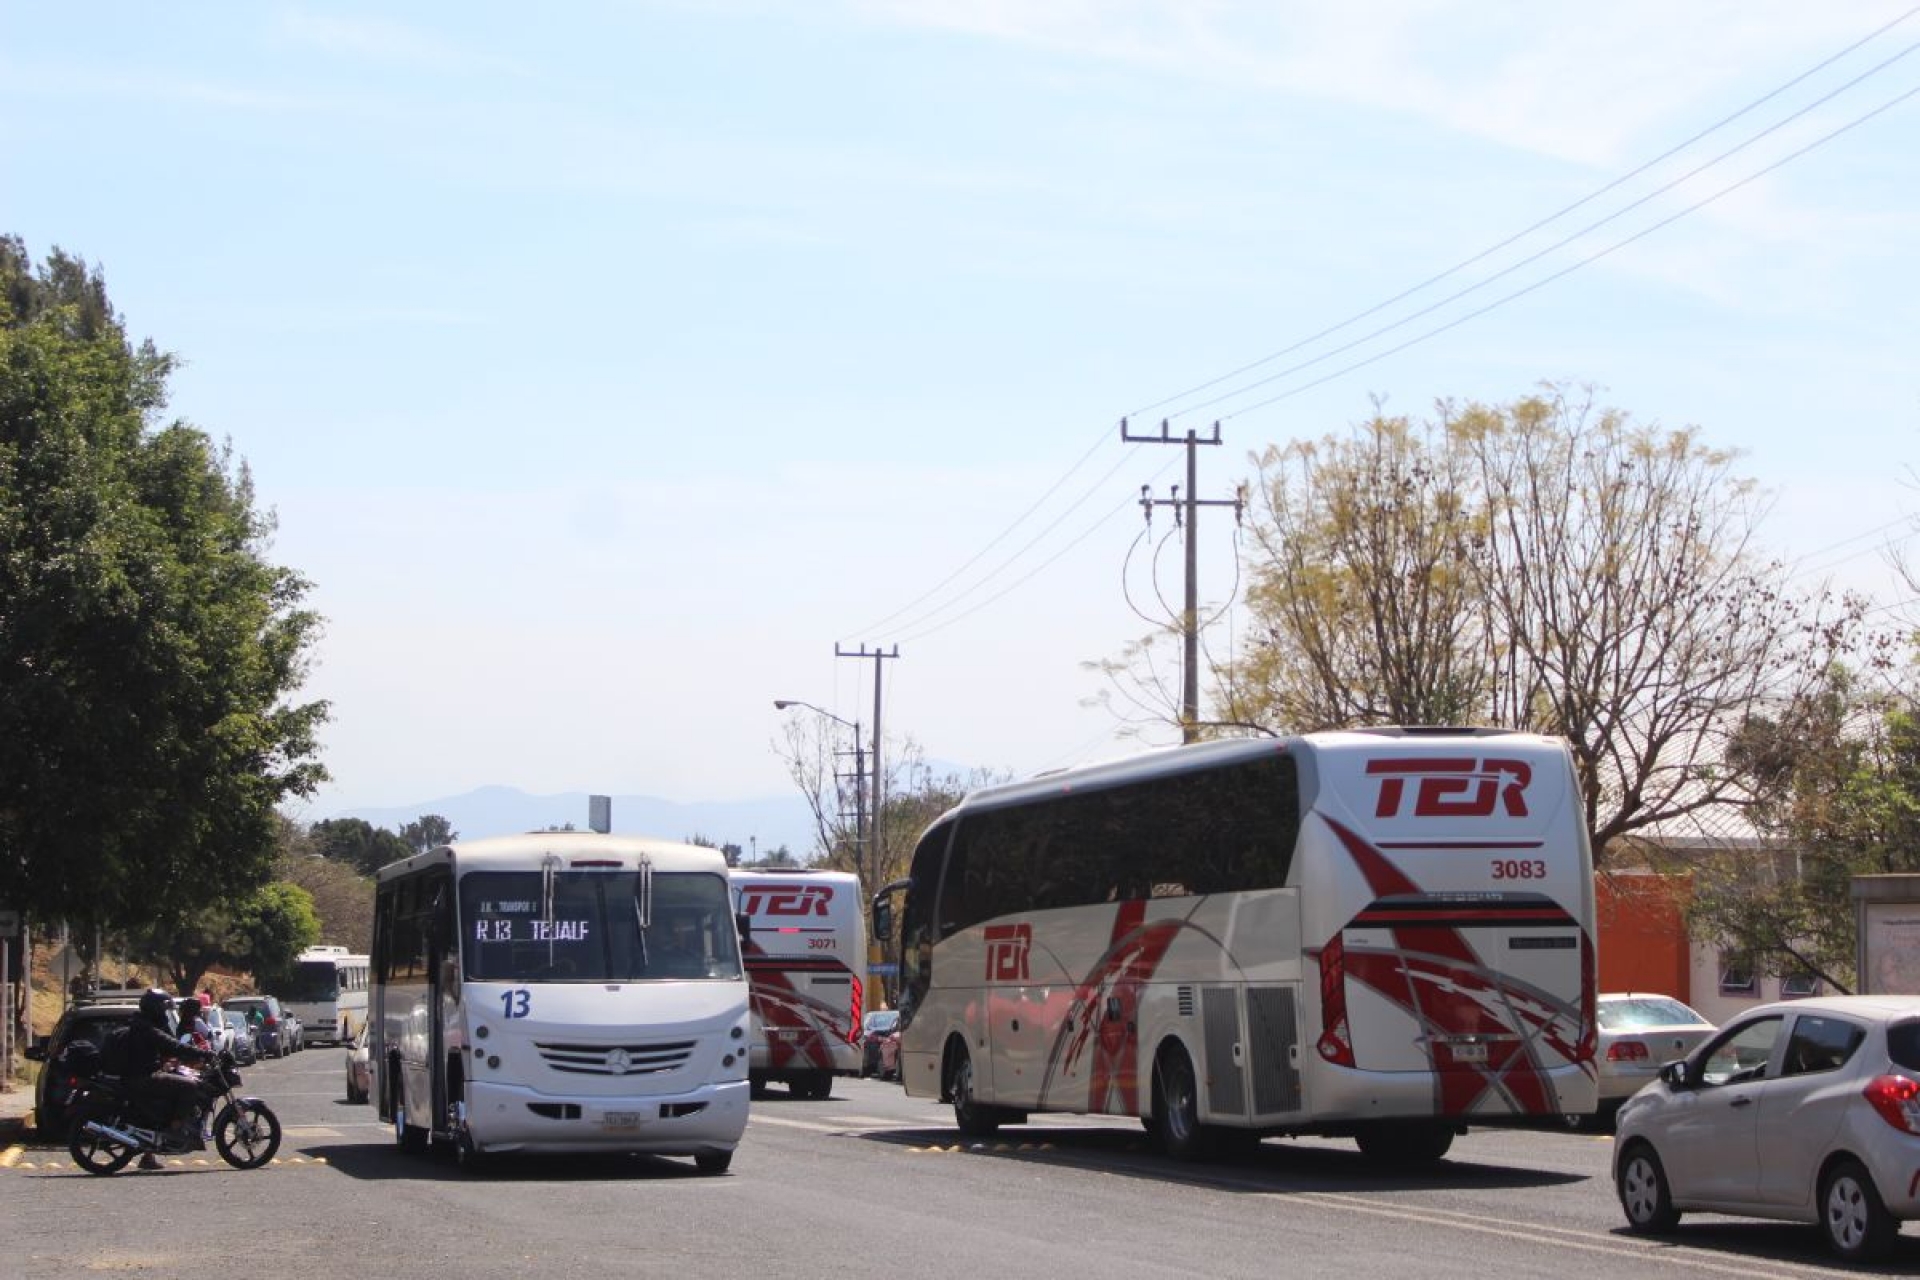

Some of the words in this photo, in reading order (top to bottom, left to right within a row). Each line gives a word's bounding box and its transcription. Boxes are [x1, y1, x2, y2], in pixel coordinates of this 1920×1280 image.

[1365, 758, 1533, 818] TER
[1491, 860, 1547, 879] 3083
[476, 920, 489, 940] R
[495, 920, 512, 940] 13
[806, 938, 836, 949] 3071
[500, 989, 531, 1018] 13
